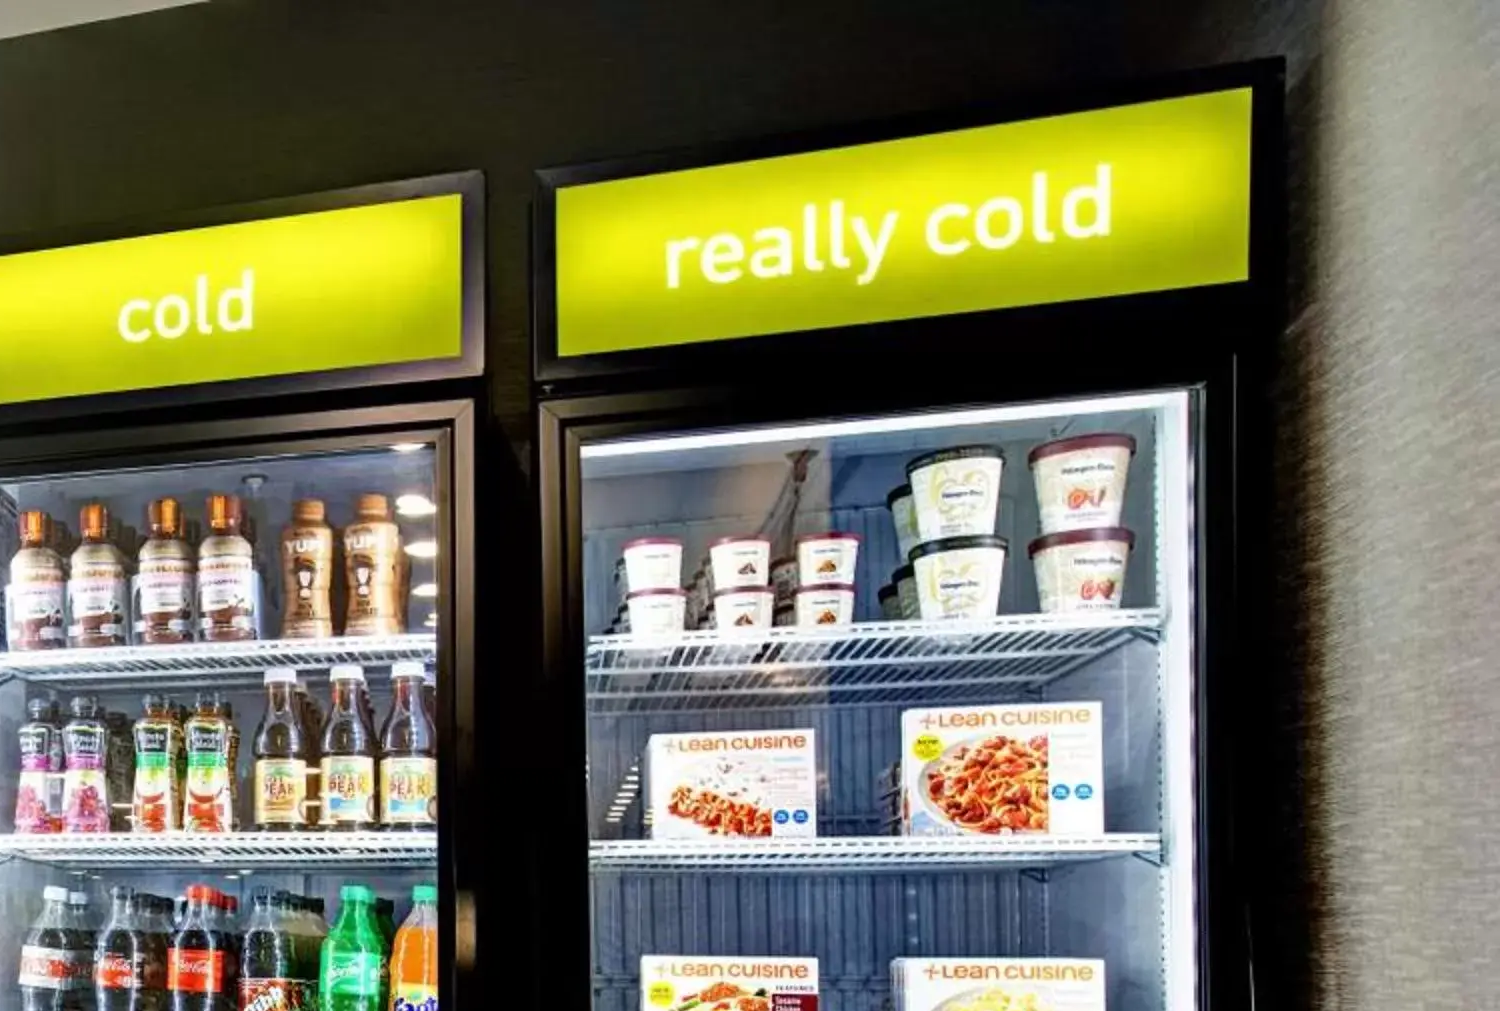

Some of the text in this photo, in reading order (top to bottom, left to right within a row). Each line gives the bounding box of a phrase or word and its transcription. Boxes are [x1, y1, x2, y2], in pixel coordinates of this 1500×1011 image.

[664, 164, 1112, 289] really cold
[117, 269, 256, 343] cold
[939, 708, 1091, 728] Lean cuisine
[678, 734, 807, 752] Lean cuisine
[671, 962, 809, 979] Lean cuisine
[942, 964, 1094, 982] Lean cuisine
